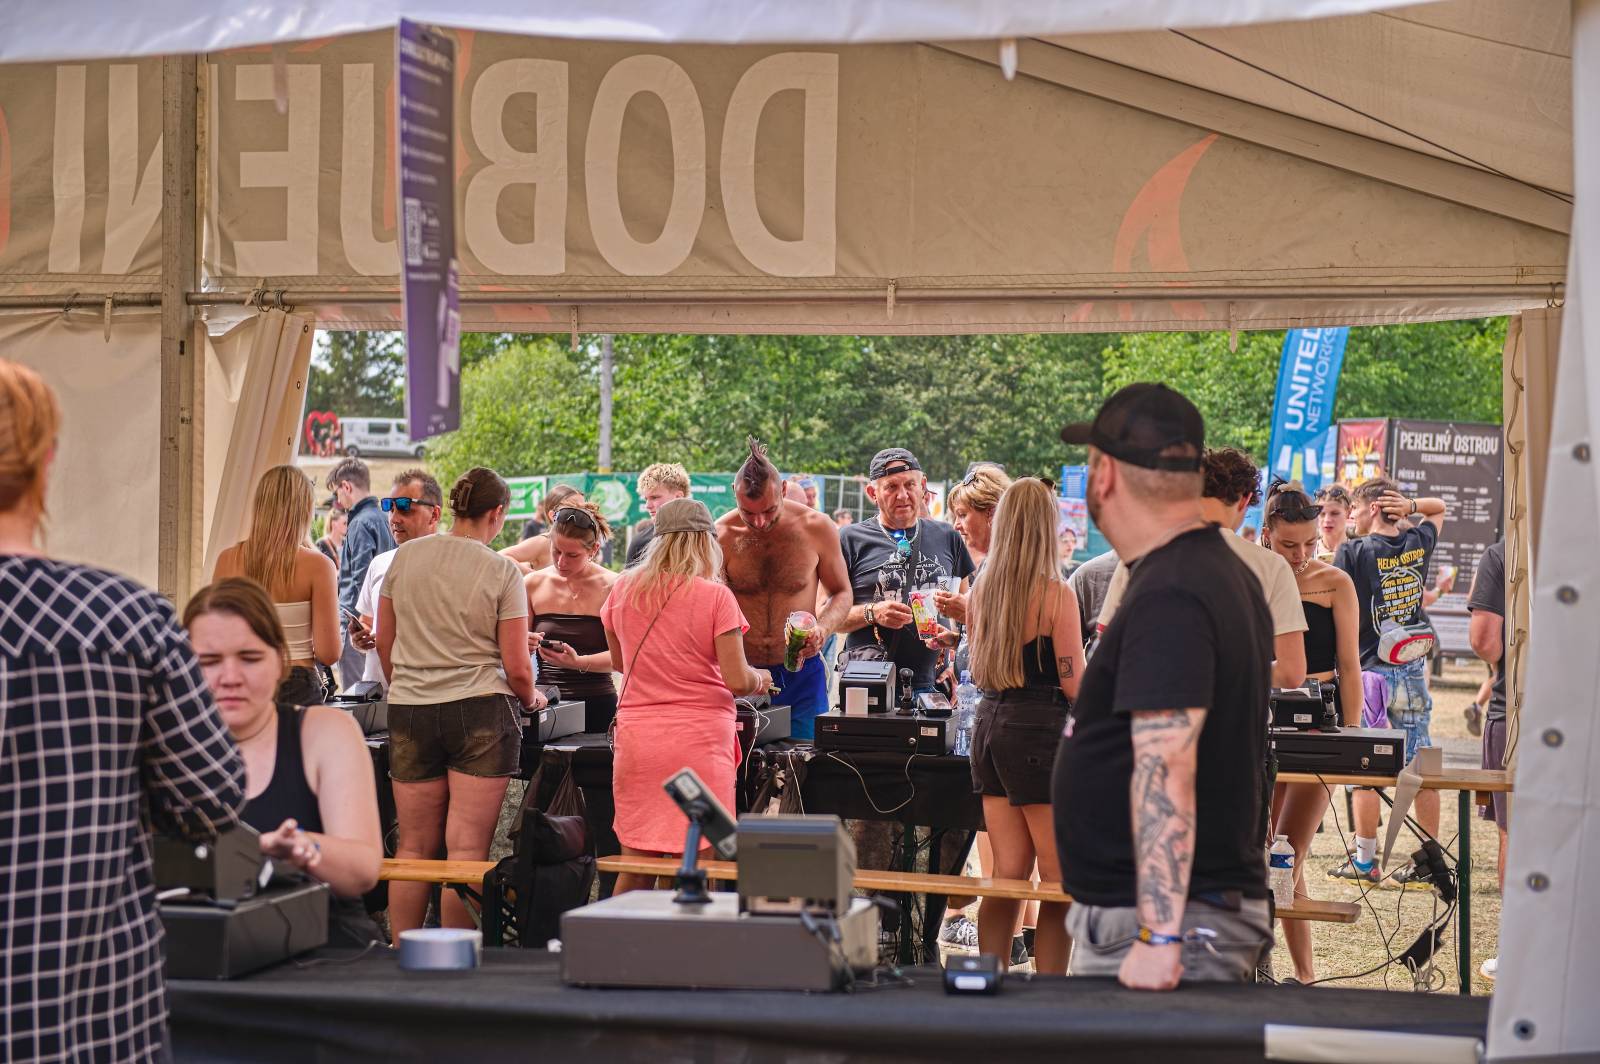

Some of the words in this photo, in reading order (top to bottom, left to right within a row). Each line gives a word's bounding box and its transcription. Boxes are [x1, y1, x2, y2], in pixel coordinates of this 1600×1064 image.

[1305, 328, 1337, 432] NETWORKS
[1400, 429, 1452, 452] PEKELNÝ
[1453, 433, 1499, 455] OSTROV
